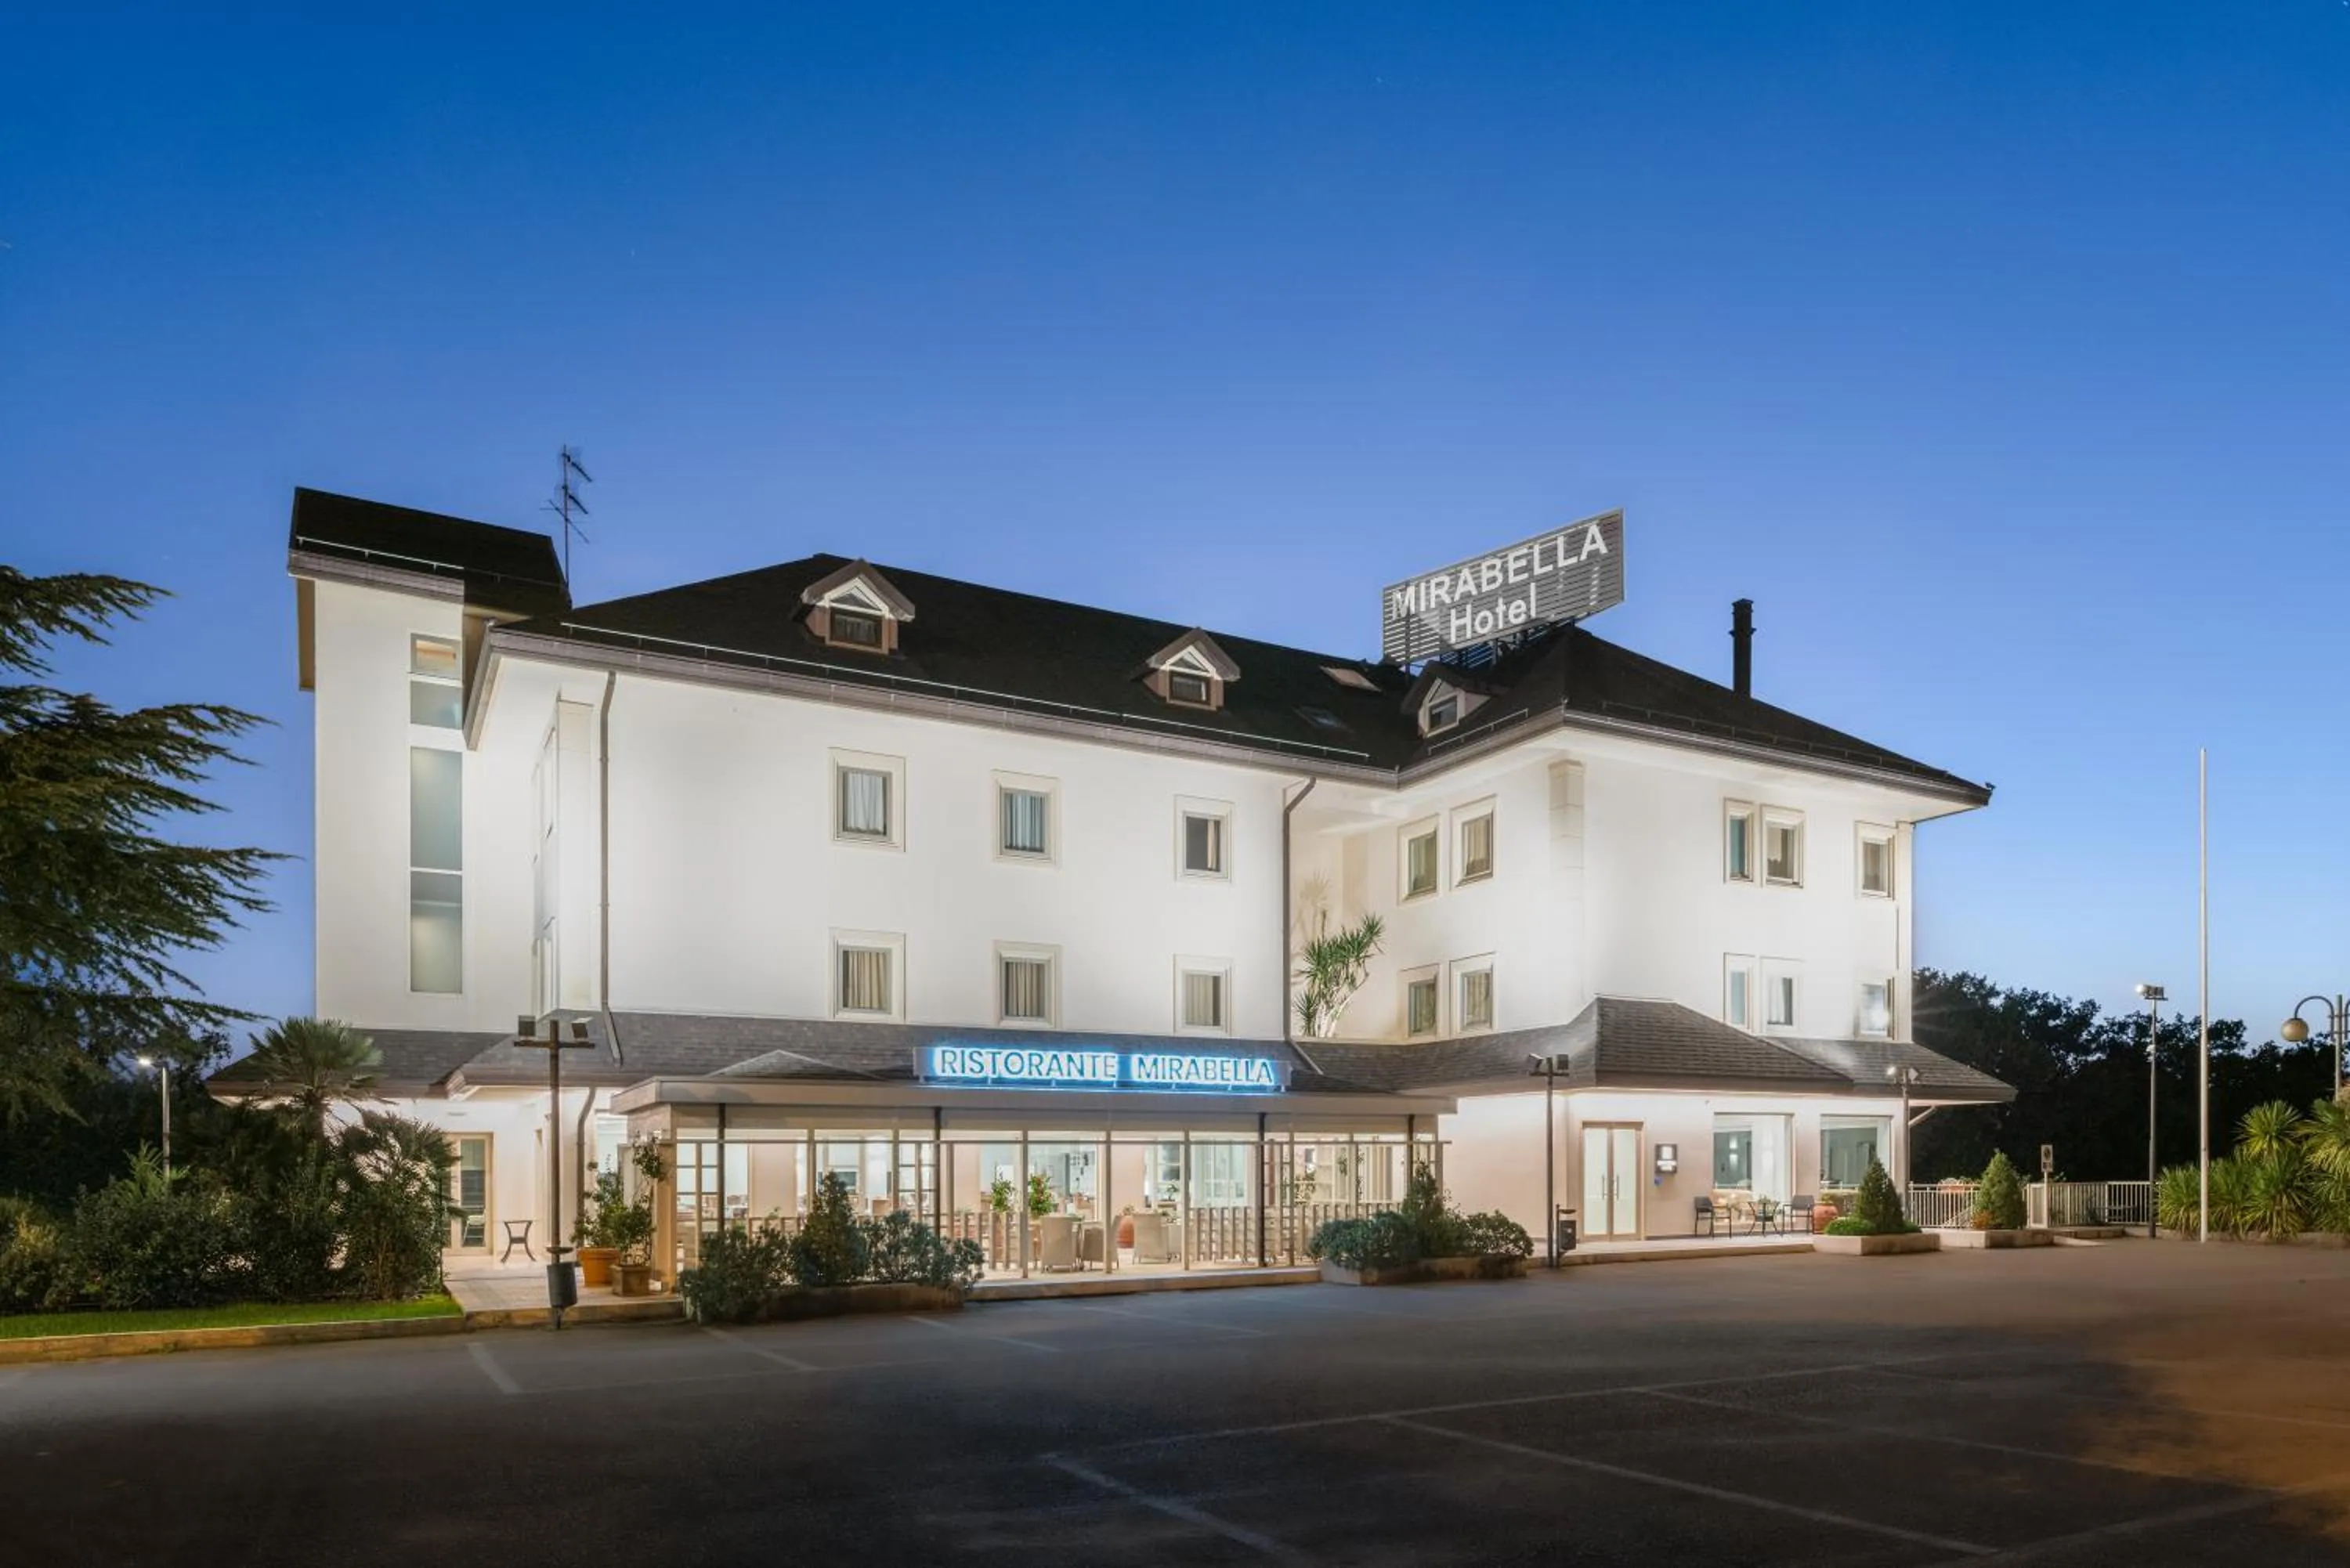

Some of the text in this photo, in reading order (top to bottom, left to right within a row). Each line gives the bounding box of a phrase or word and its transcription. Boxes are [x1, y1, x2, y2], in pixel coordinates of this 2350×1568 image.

[1391, 524, 1608, 620] MIRABELLA
[1450, 582, 1536, 642] Hotel
[940, 1049, 1274, 1083] RISTORANTE MIRABELLA
